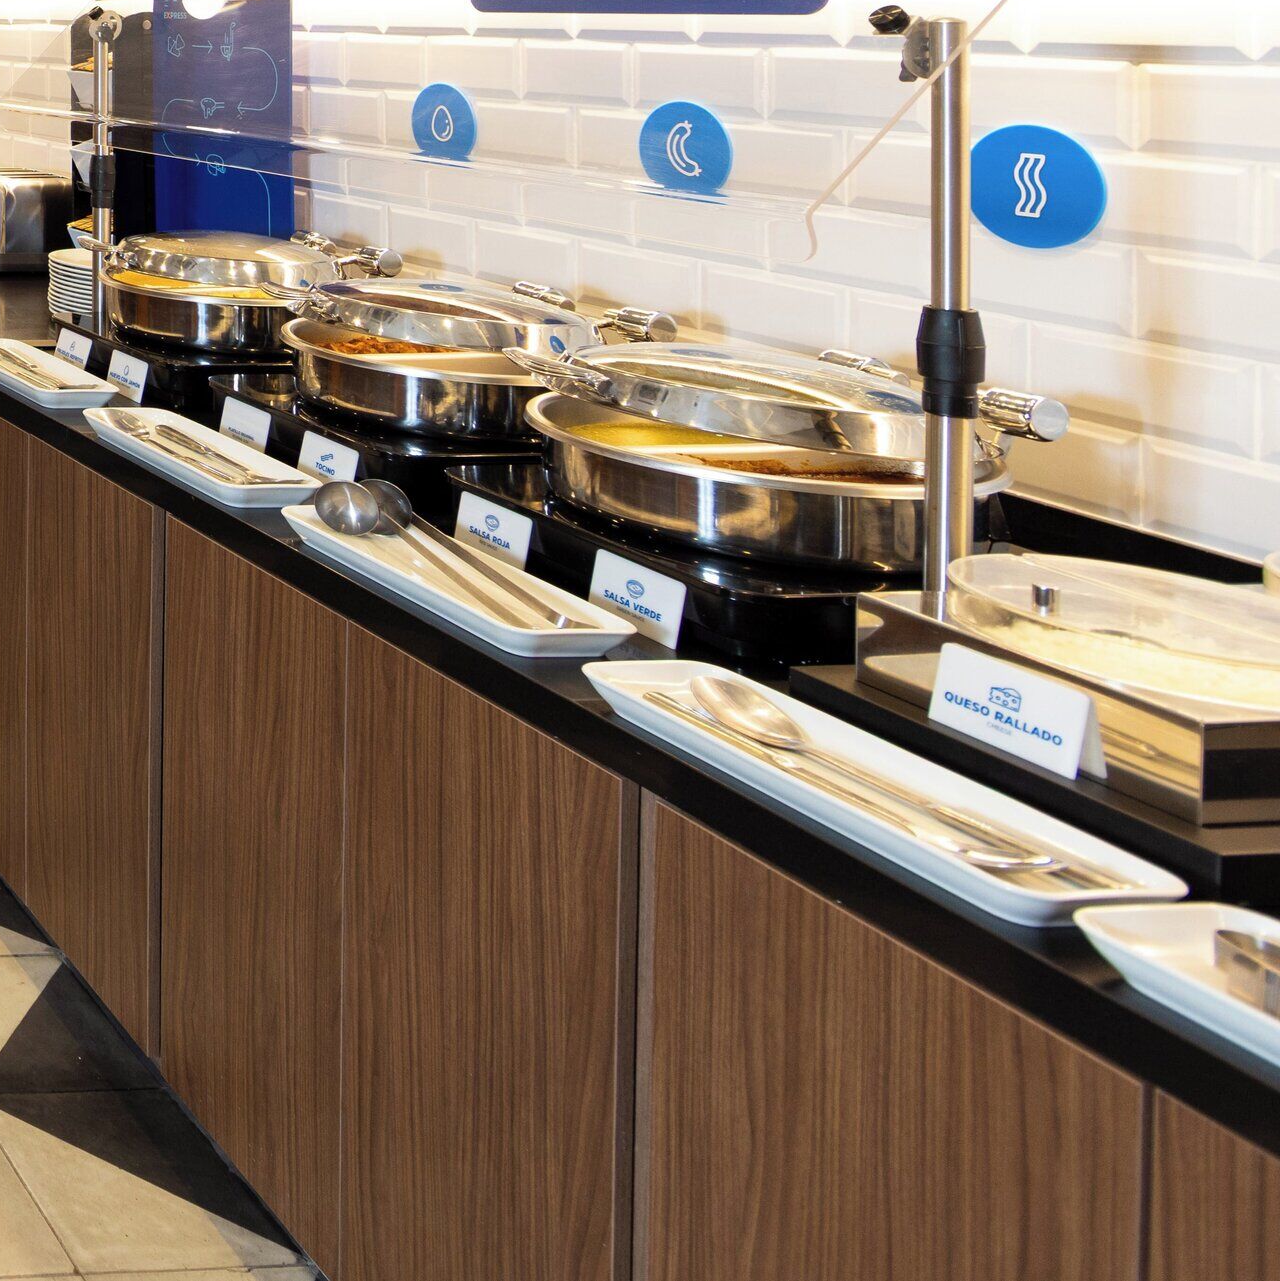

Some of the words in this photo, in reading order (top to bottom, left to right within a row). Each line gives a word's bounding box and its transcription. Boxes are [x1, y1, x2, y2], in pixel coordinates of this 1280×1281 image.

[163, 11, 188, 20] EXPRESS
[315, 461, 336, 476] TOCINO
[469, 525, 491, 541] SALSA
[492, 535, 511, 550] ROJA
[603, 589, 630, 608] SALSA
[633, 602, 662, 622] VERDE
[944, 691, 990, 717] QUESO
[993, 710, 1063, 747] RALLADO
